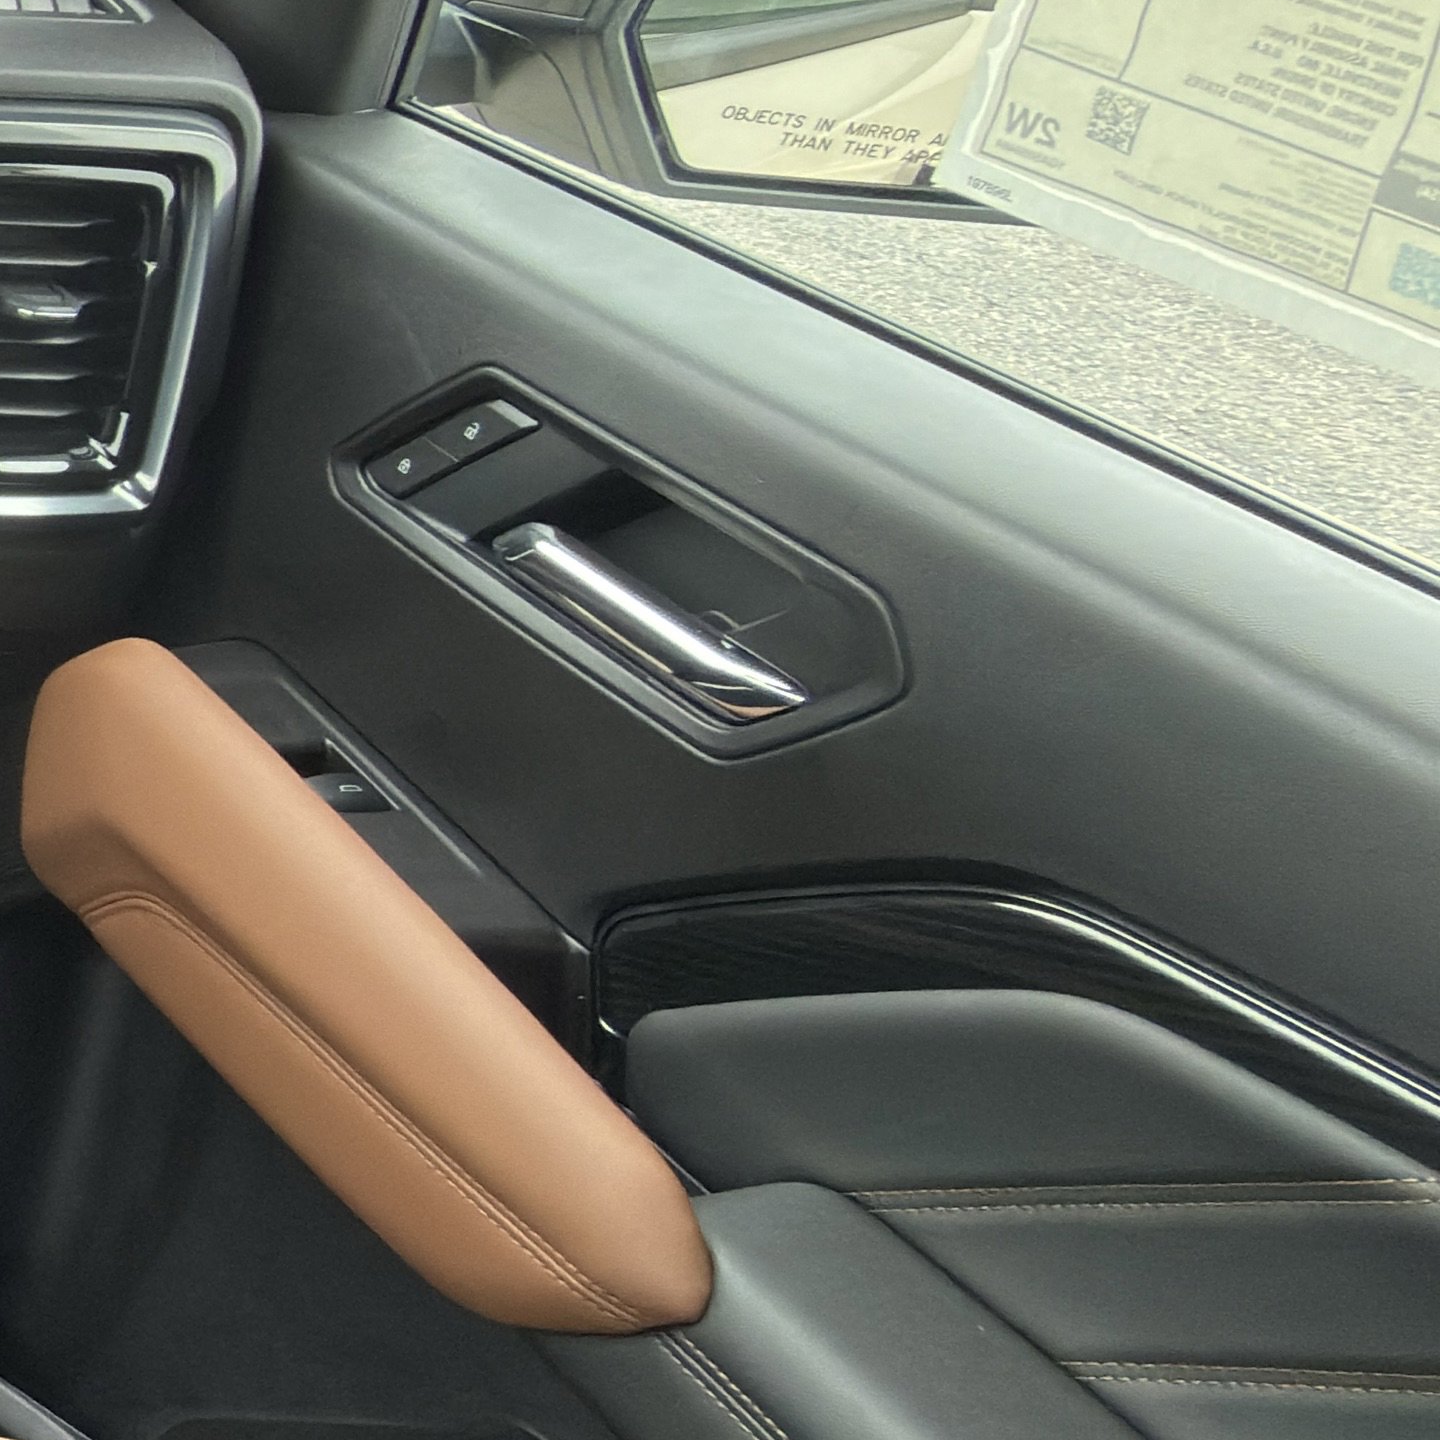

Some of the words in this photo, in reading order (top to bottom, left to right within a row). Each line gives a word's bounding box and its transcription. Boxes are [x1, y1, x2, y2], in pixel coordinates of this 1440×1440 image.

[721, 105, 808, 130] OBJECTS
[814, 117, 836, 133] IN
[845, 121, 922, 144] MIRROR
[779, 131, 832, 153] THAN
[843, 140, 895, 161] THEY
